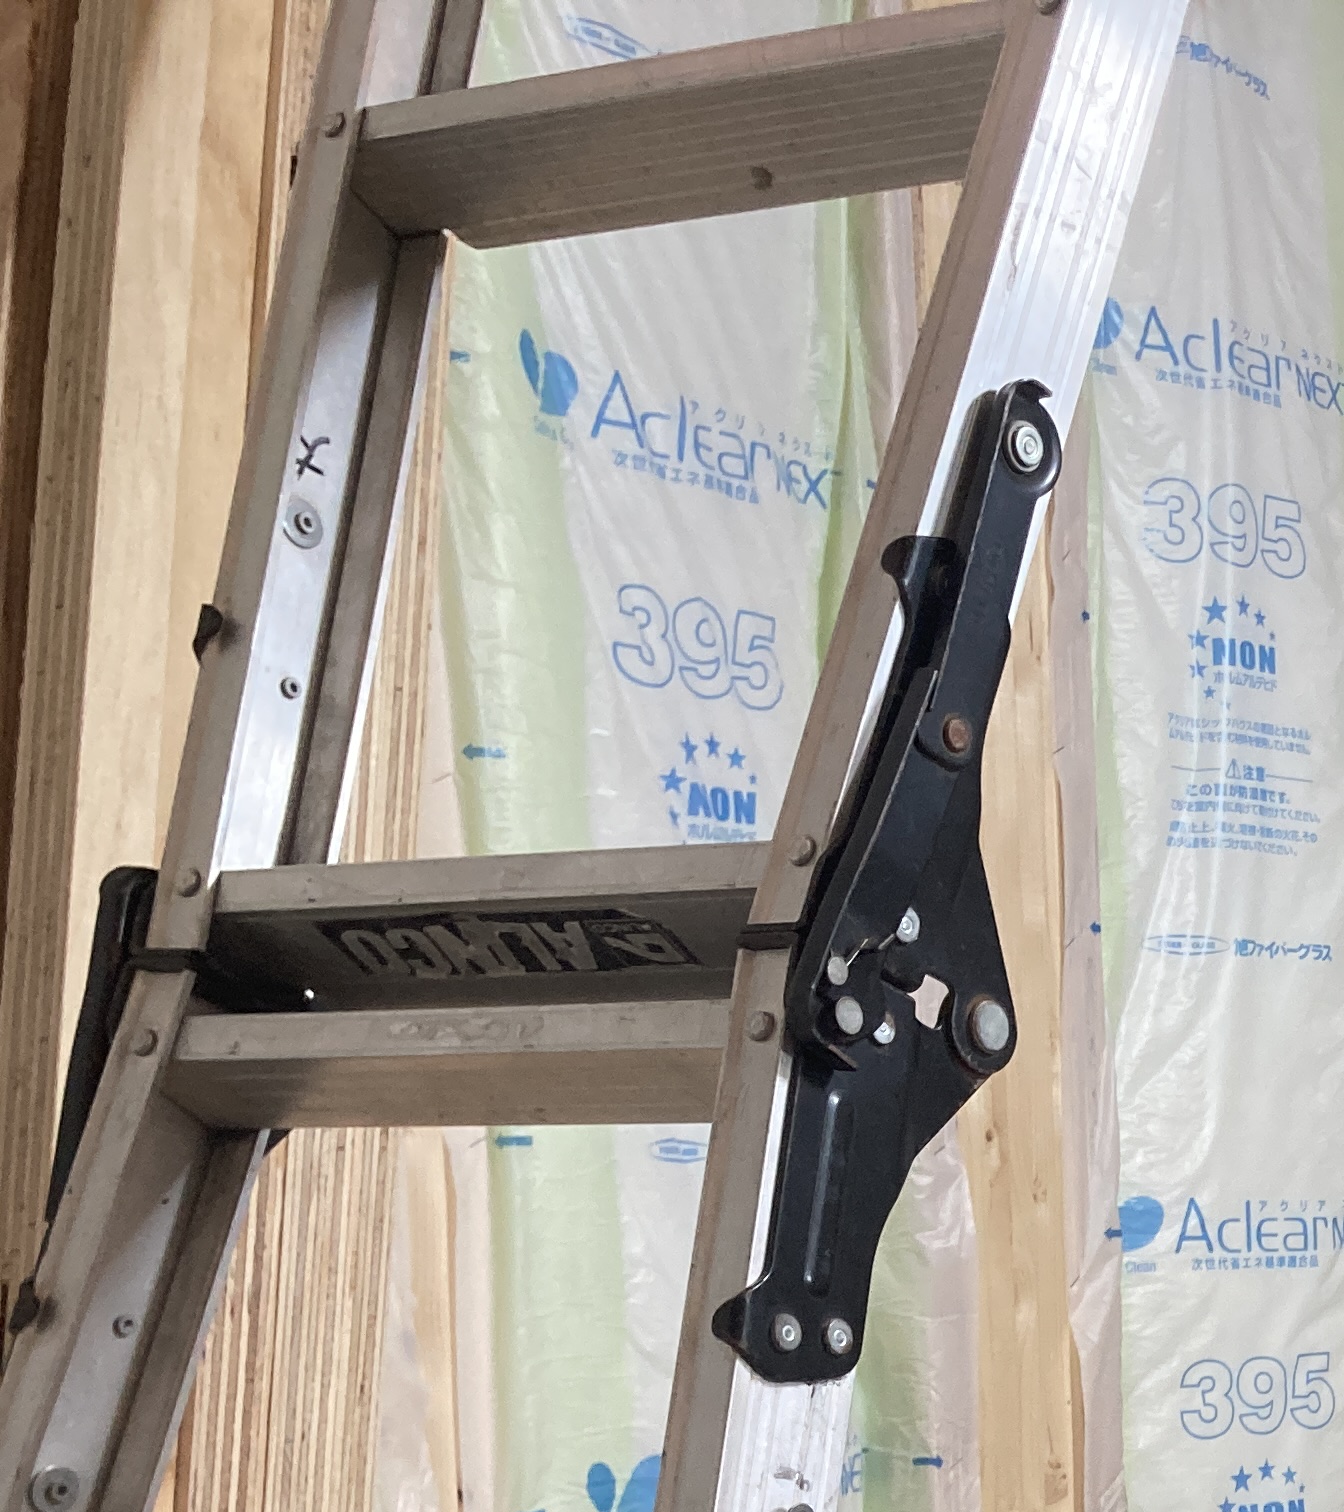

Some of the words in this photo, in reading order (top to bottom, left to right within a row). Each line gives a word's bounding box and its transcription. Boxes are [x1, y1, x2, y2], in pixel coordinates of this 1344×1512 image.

[1142, 476, 1306, 579] 395
[613, 584, 784, 711] 395
[1211, 637, 1277, 675] NON
[1234, 938, 1332, 962] 旭ファイバーグラス
[1180, 1353, 1335, 1440] 395
